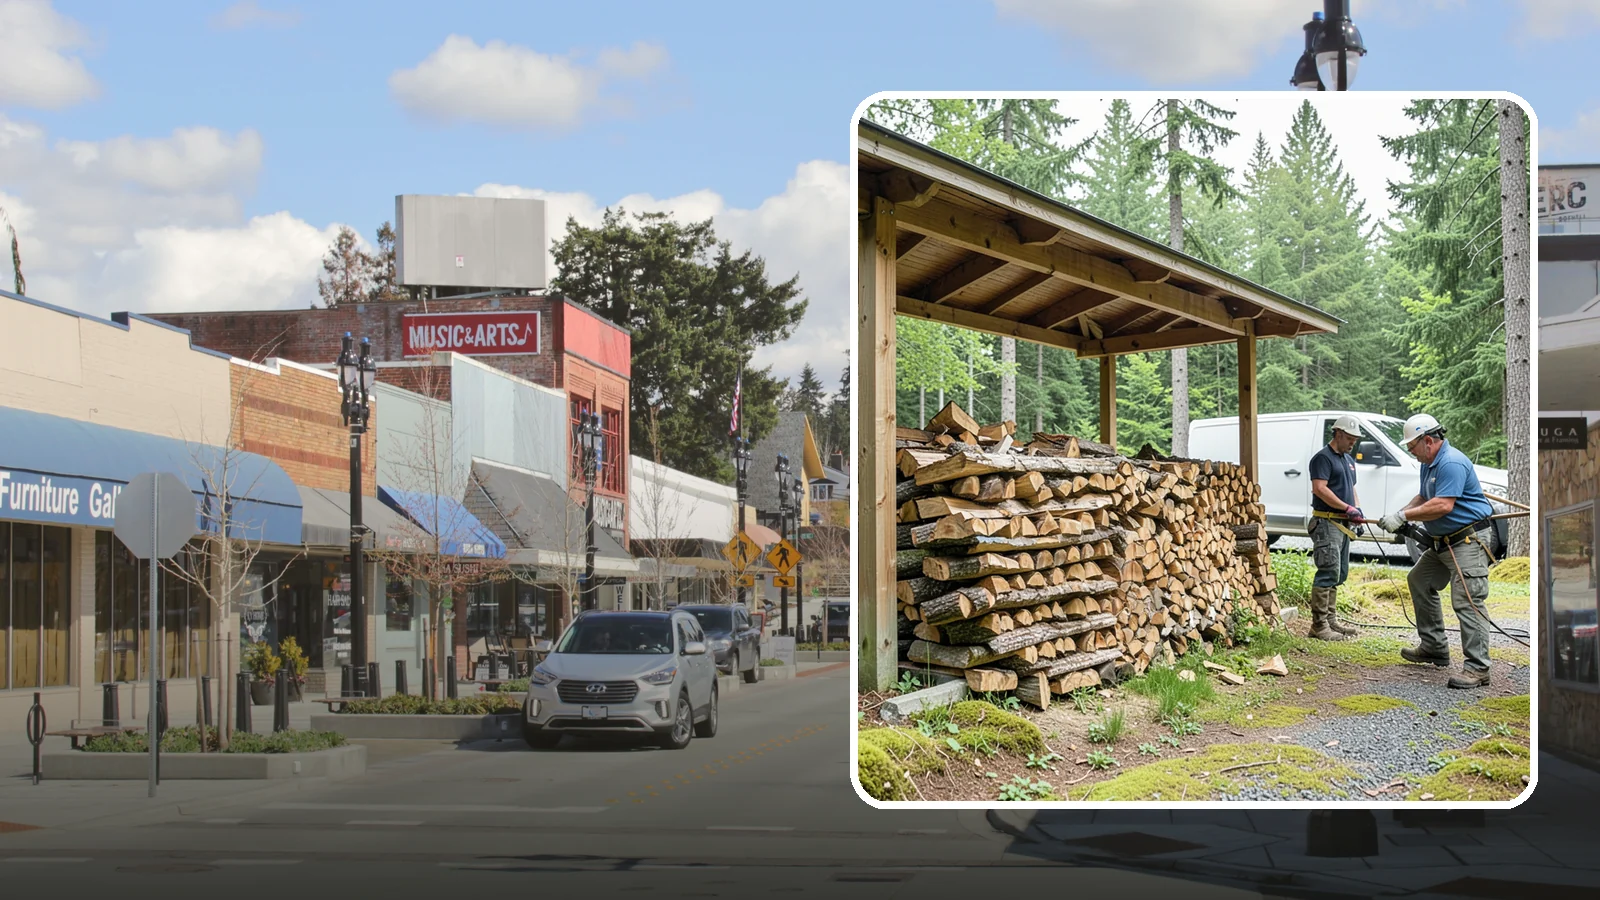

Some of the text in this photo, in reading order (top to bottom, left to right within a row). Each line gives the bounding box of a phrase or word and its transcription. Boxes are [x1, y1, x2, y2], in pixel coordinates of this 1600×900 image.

[408, 323, 520, 349] MUSIC&ARTS
[0, 471, 122, 519] Furniture Gal
